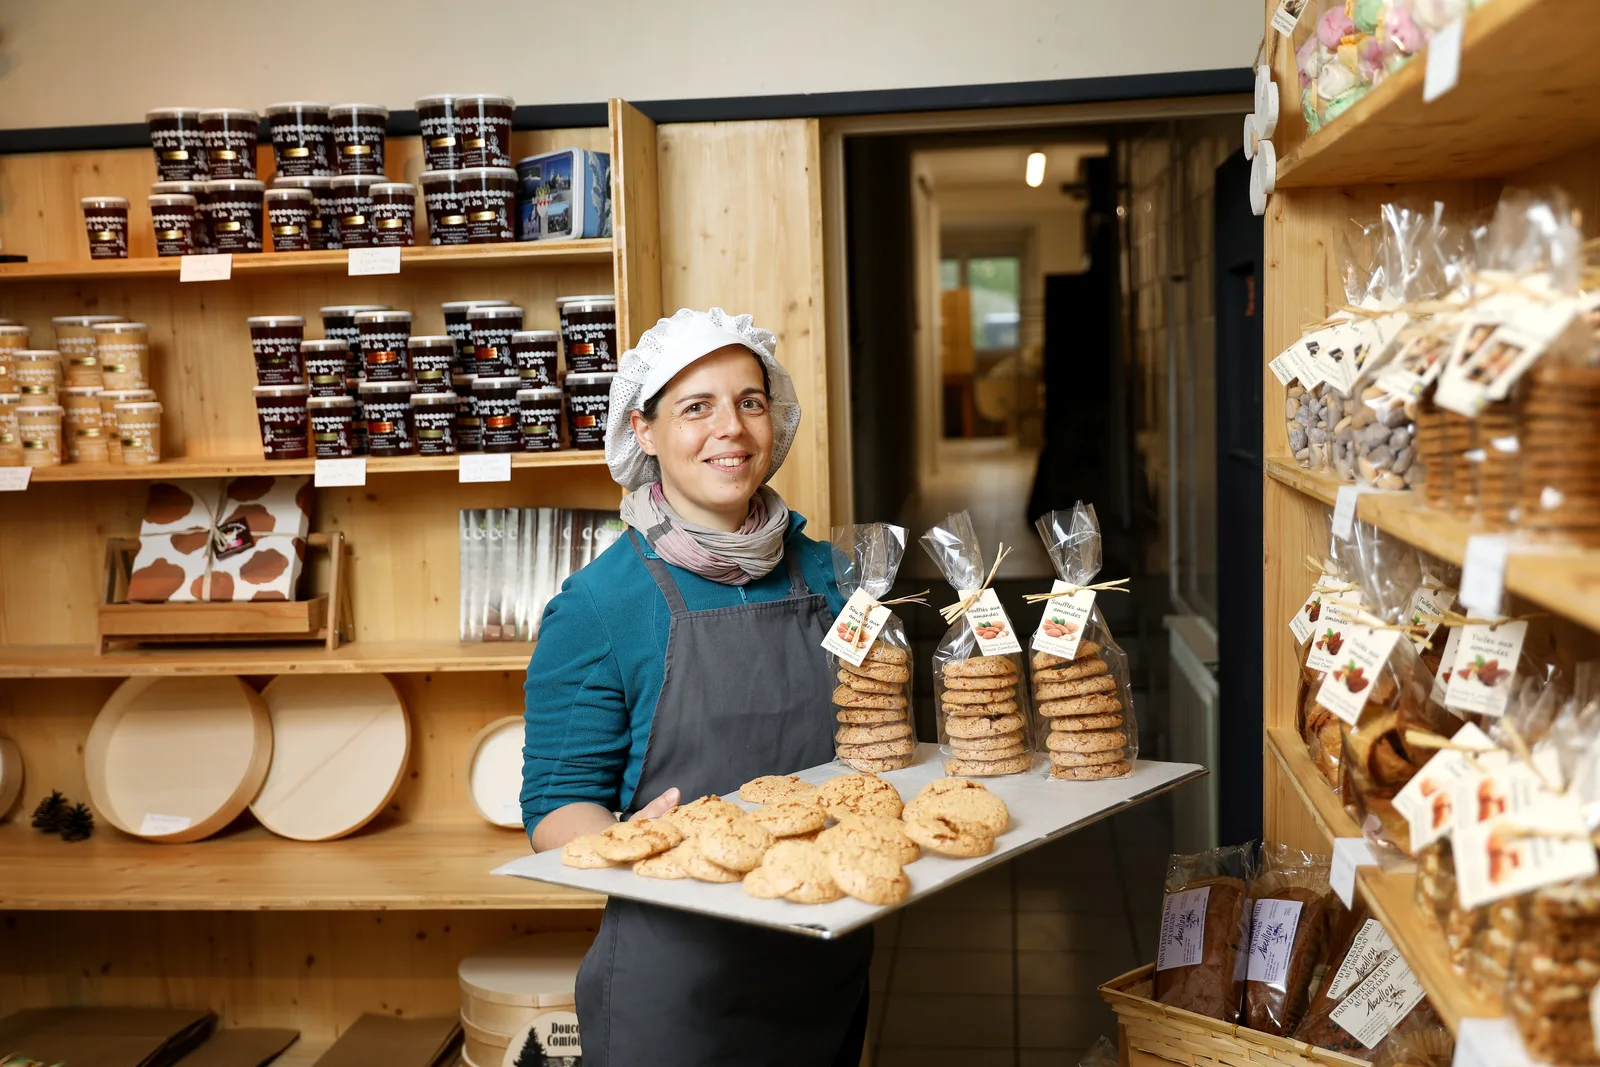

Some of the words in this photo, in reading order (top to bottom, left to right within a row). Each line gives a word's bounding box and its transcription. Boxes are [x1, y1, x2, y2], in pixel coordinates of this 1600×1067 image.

[436, 124, 448, 134] du
[476, 124, 496, 136] jura
[446, 199, 458, 209] du
[484, 198, 505, 209] jura
[230, 209, 251, 220] jura
[289, 215, 306, 225] jura
[394, 210, 411, 220] jura
[488, 336, 508, 347] jura
[584, 330, 606, 343] jura
[264, 345, 274, 353] du
[277, 345, 296, 356] jura
[387, 340, 405, 351] jura
[432, 361, 449, 372] jura
[527, 358, 544, 368] jura
[493, 406, 504, 415] du
[586, 402, 606, 415] jura
[284, 414, 295, 422] du
[384, 410, 403, 422] jura
[527, 415, 536, 423] du
[538, 415, 555, 426] jura
[317, 422, 326, 430] du
[327, 422, 344, 432] jura
[422, 419, 431, 427] du
[433, 419, 449, 430] jura
[1051, 599, 1075, 610] Soufflés
[1053, 608, 1081, 619] amandes
[1326, 606, 1340, 615] Tuile
[1330, 979, 1342, 995] PAIN
[1362, 922, 1374, 939] MIEL
[1344, 969, 1352, 980] AU
[1349, 938, 1369, 971] CHOCOLAT
[1333, 1004, 1349, 1018] PAIN
[1372, 969, 1384, 982] PUR
[1382, 953, 1400, 972] MIEL
[1354, 998, 1363, 1009] AU
[1361, 971, 1390, 1001] CHOCOLAT
[1366, 983, 1395, 1016] Abeillou
[547, 1034, 580, 1047] Comtoi
